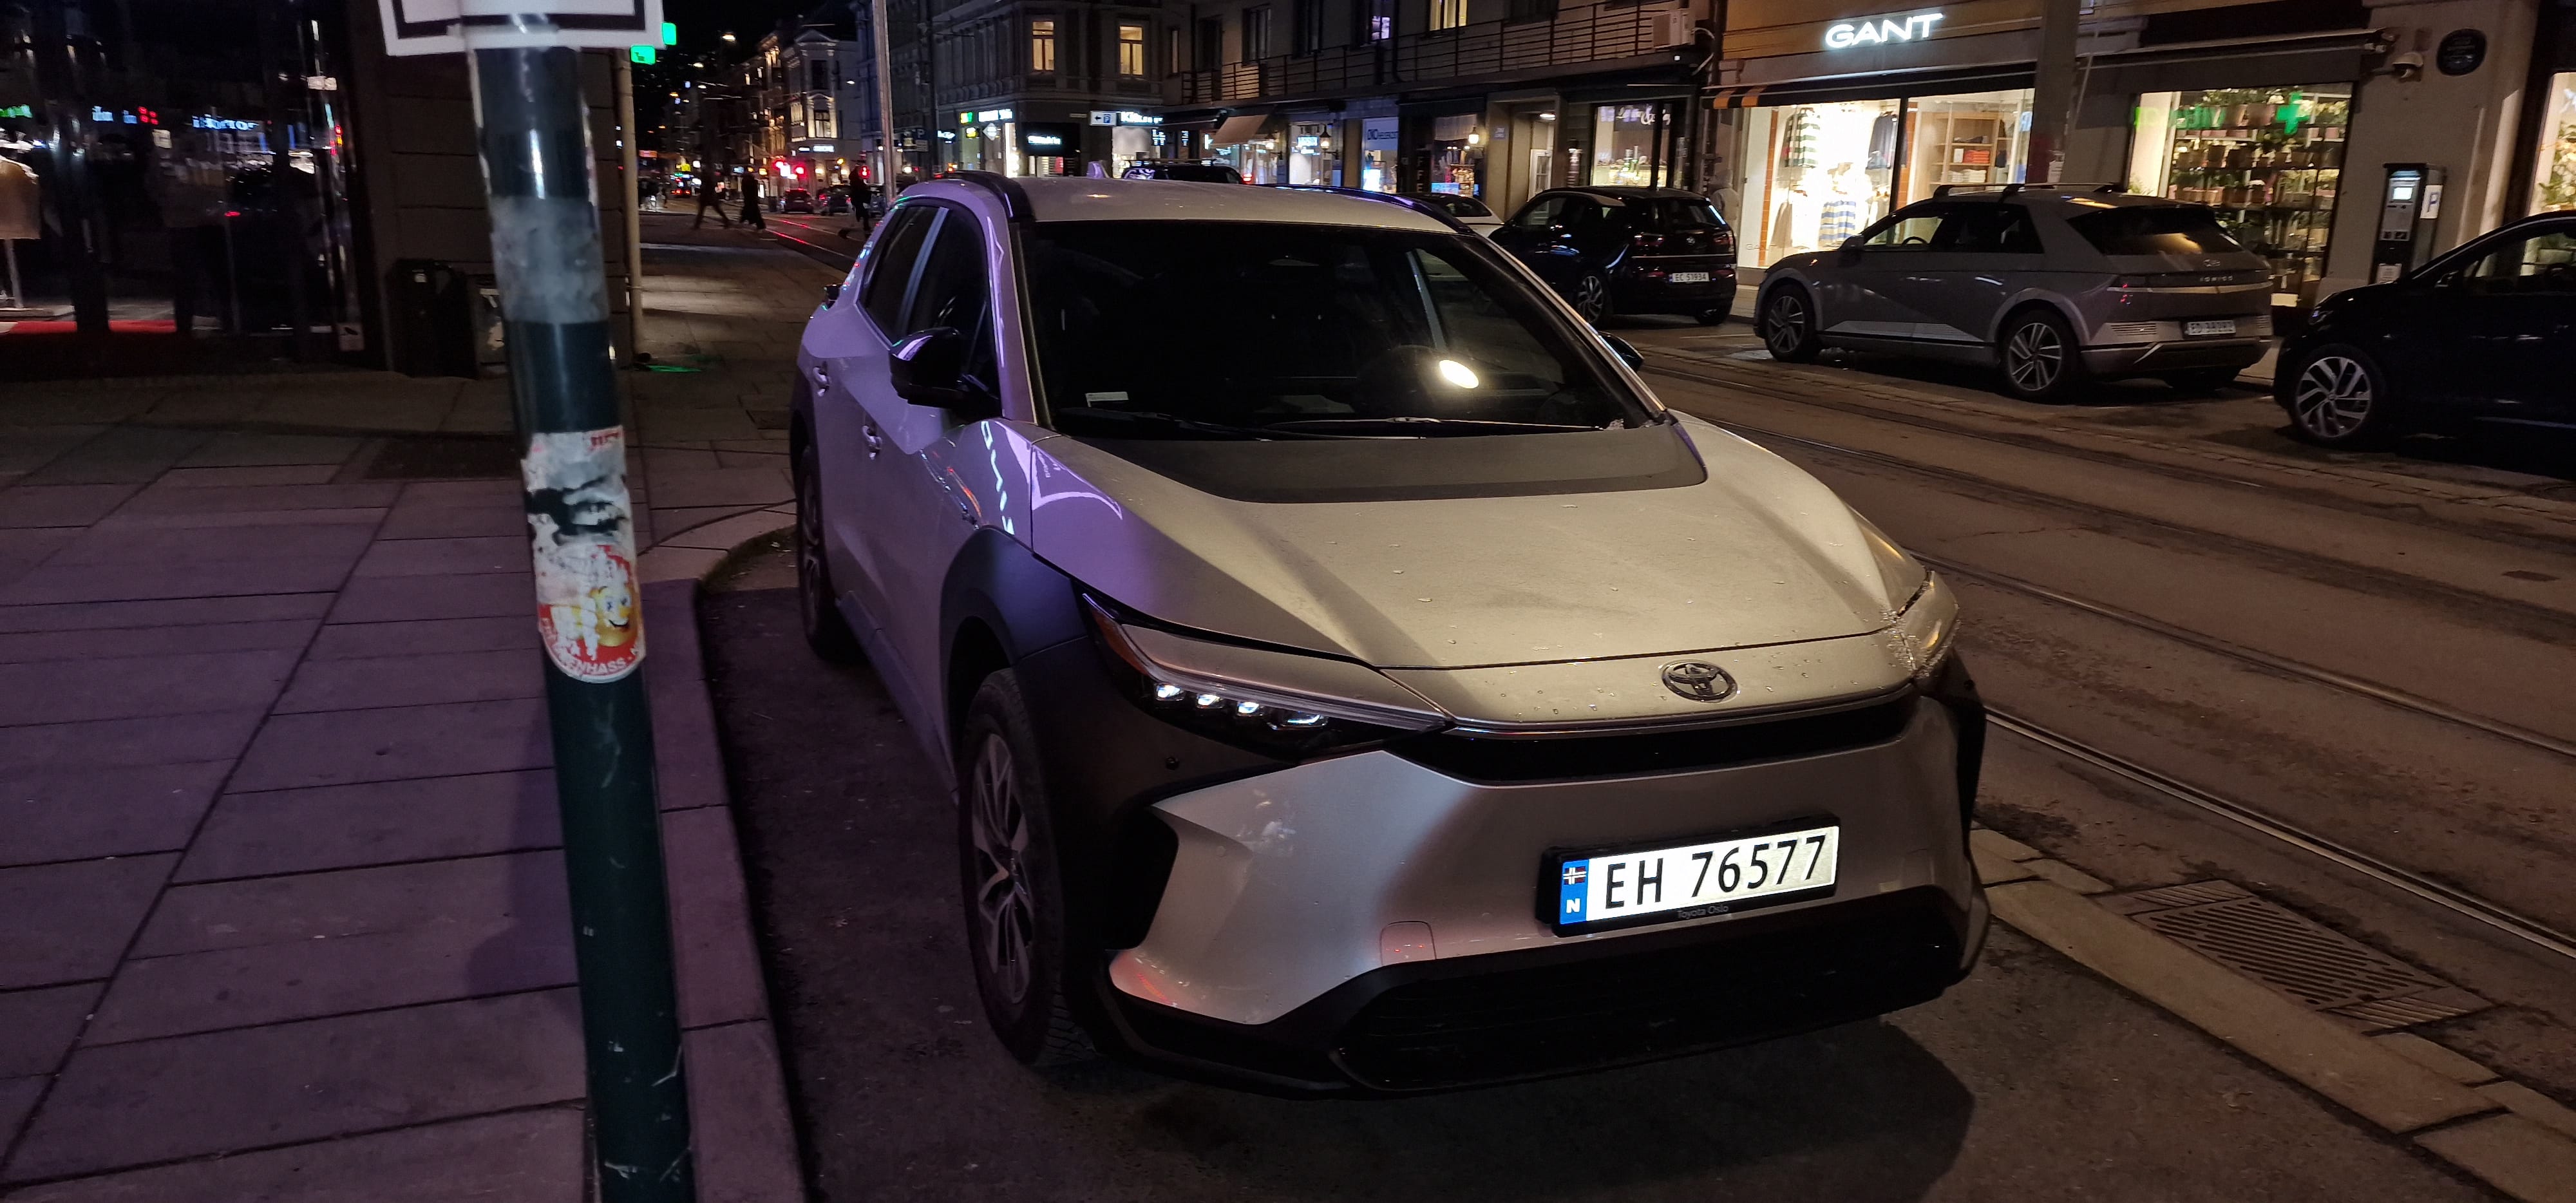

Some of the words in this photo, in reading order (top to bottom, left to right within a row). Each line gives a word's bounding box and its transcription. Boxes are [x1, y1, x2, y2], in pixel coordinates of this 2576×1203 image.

[1826, 13, 1943, 48] GANT
[2427, 192, 2439, 213] P
[1605, 858, 1664, 909] EH
[1691, 835, 1827, 898] 76577
[1566, 898, 1581, 913] N
[1677, 908, 1707, 920] Toyota
[1708, 903, 1729, 914] Oslo
